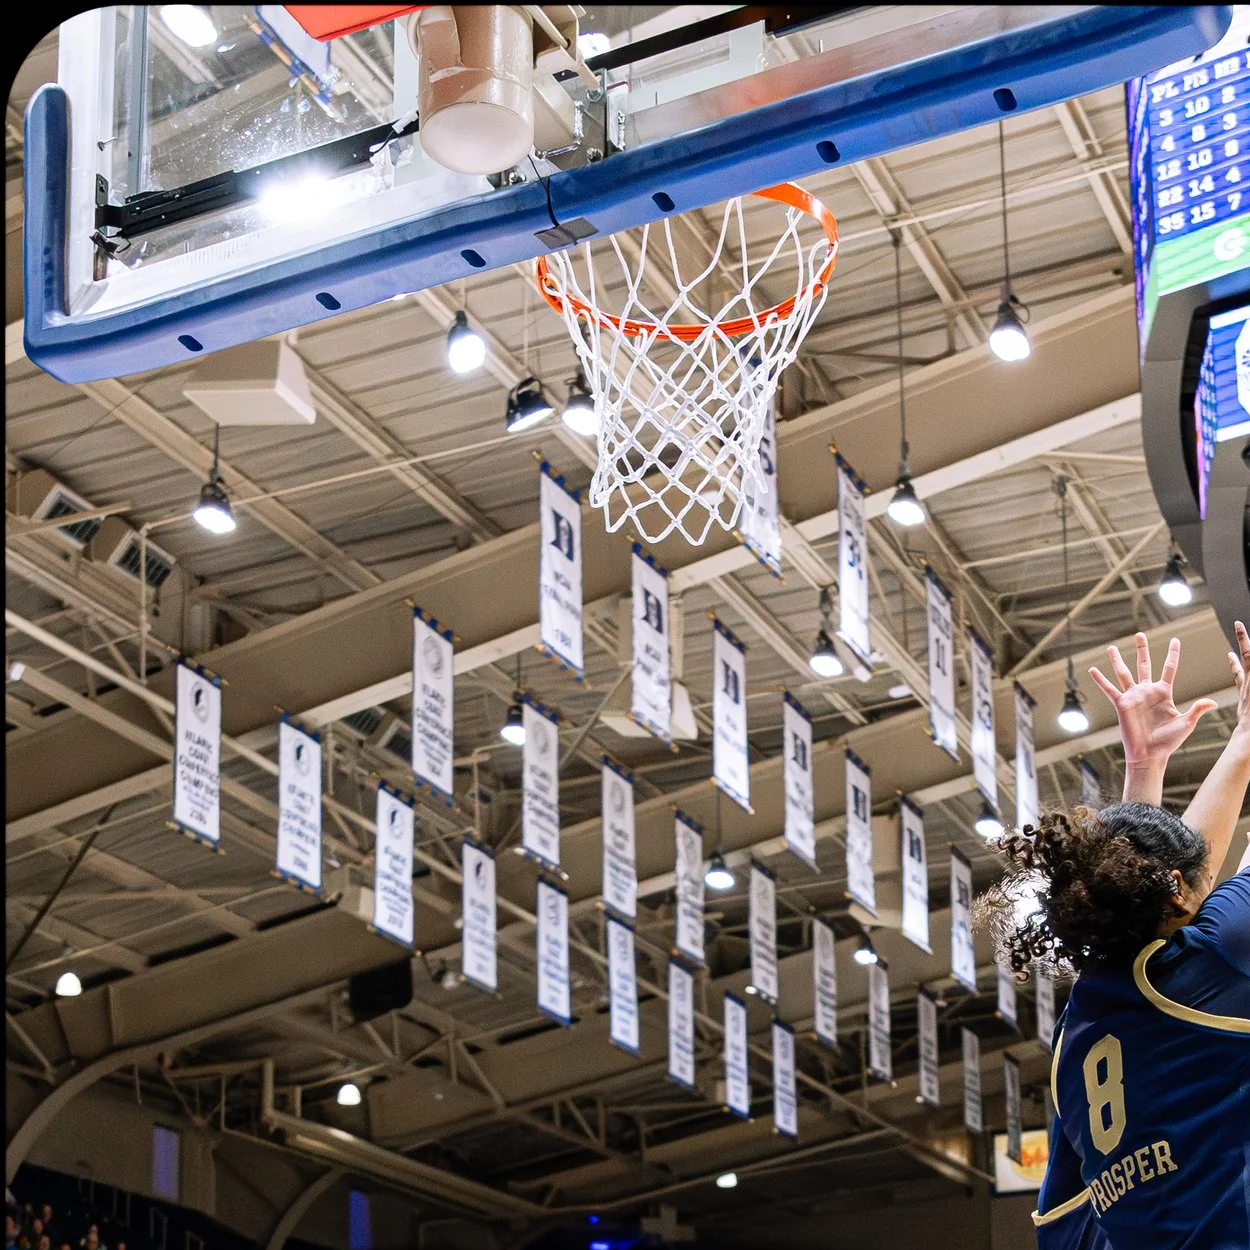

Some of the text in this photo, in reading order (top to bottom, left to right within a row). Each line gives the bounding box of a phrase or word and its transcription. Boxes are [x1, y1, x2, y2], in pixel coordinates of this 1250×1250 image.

[1151, 80, 1179, 103] PL
[1159, 108, 1173, 127] 3
[1185, 96, 1209, 118] 10
[1161, 135, 1175, 152] 4
[1157, 159, 1181, 181] 12
[1188, 149, 1212, 170] 10
[1188, 175, 1214, 197] 14
[1225, 166, 1241, 183] 4
[1190, 201, 1216, 224] 15
[1227, 192, 1242, 211] 7
[1083, 1033, 1127, 1156] 8
[1088, 1140, 1178, 1212] PROSPER
